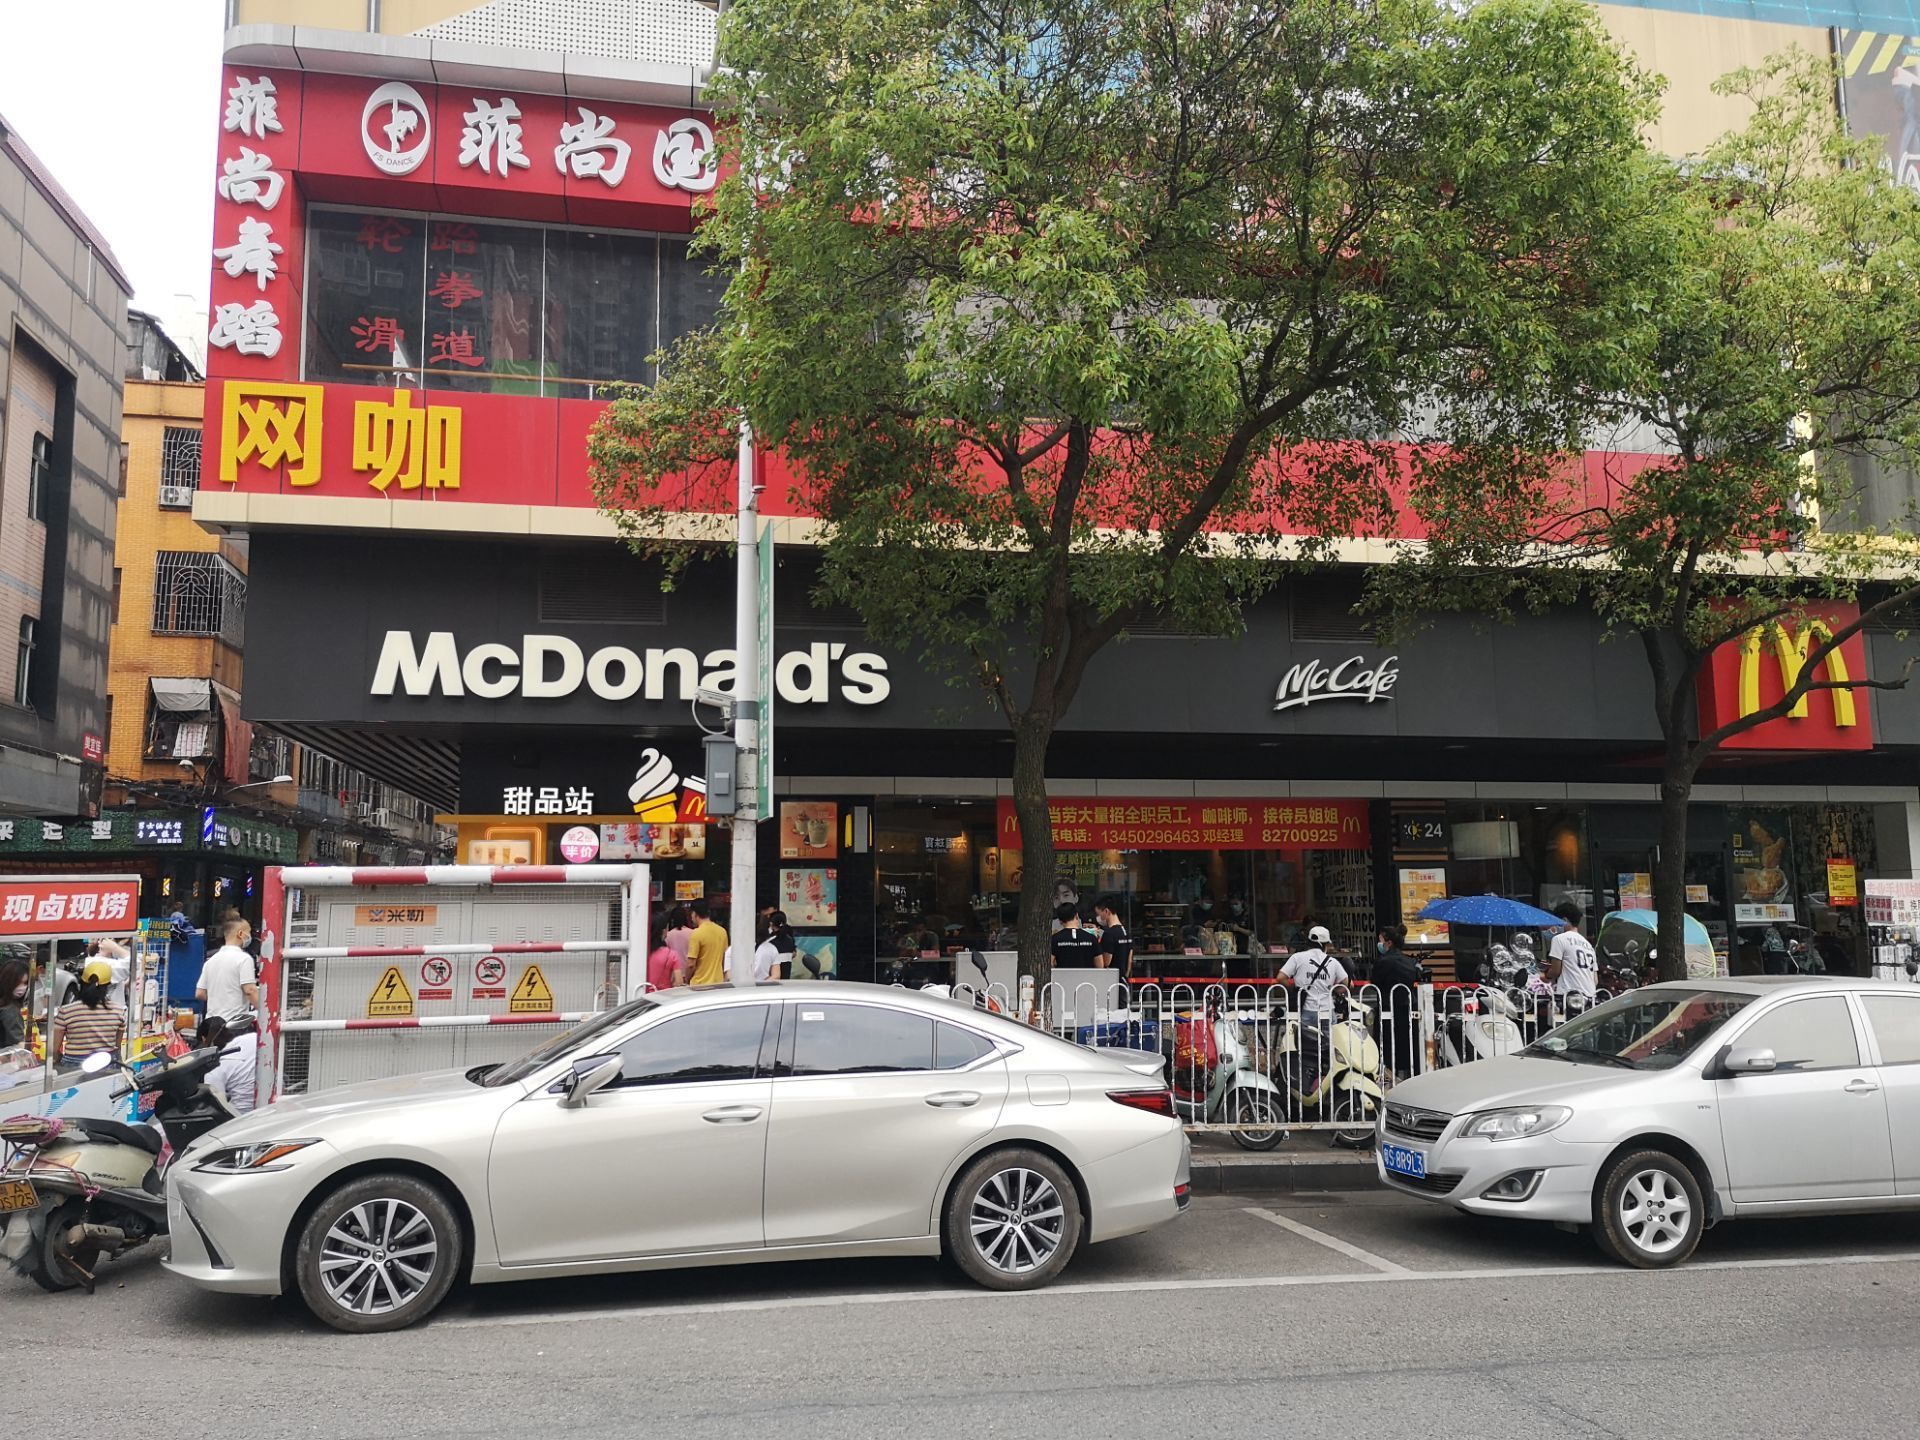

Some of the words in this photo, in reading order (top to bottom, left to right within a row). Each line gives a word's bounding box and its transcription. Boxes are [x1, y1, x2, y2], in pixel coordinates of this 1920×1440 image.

[386, 156, 414, 166] DANCE
[208, 75, 286, 360] 菲尚舞蹈
[351, 215, 412, 353] 轮滑
[429, 222, 486, 367] 跆拳道
[219, 380, 462, 490] 网咖
[370, 631, 890, 705] McDonad's
[1272, 655, 1400, 711] McCafé
[503, 786, 595, 816] 甜品站
[1263, 807, 1339, 825] 接待员姐姐
[1100, 829, 1200, 844] 13450296463
[1202, 829, 1244, 843] 邓经理
[1262, 829, 1338, 843] 82700925
[1424, 823, 1443, 838] 24
[566, 845, 594, 859] 半价
[2, 892, 130, 922] 现卤现捞
